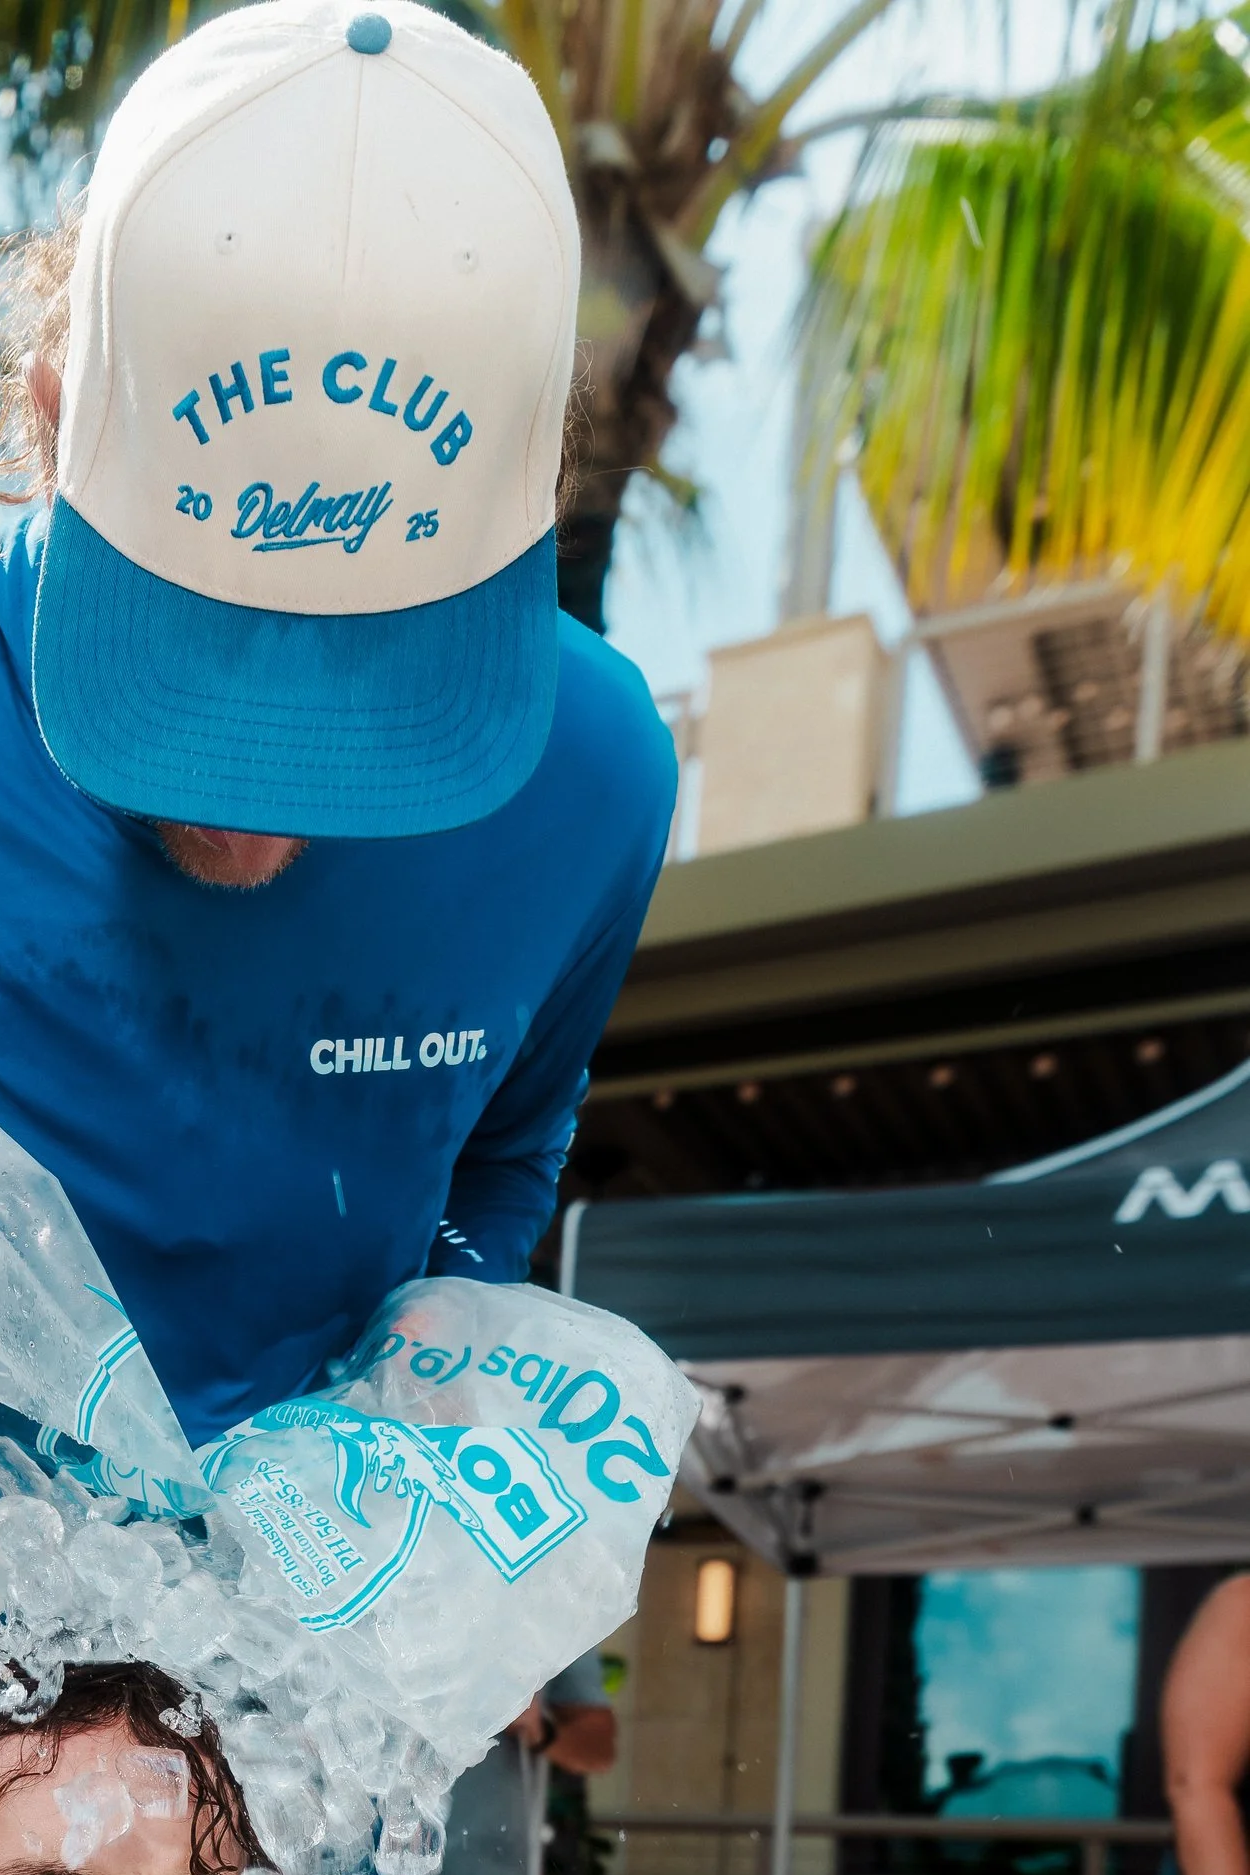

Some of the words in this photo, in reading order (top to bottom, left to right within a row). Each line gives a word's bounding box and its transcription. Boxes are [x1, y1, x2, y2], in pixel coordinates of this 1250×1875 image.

[172, 347, 292, 445] THE
[322, 351, 473, 465] CLUB
[176, 485, 213, 521] 20
[231, 481, 393, 553] Delray
[406, 509, 439, 542] 25
[310, 1036, 411, 1075] CHILL
[478, 1345, 670, 1503] 20lbs
[246, 1509, 298, 1574] Industrial
[293, 1531, 337, 1587] Boynton
[326, 1537, 364, 1573] PH
